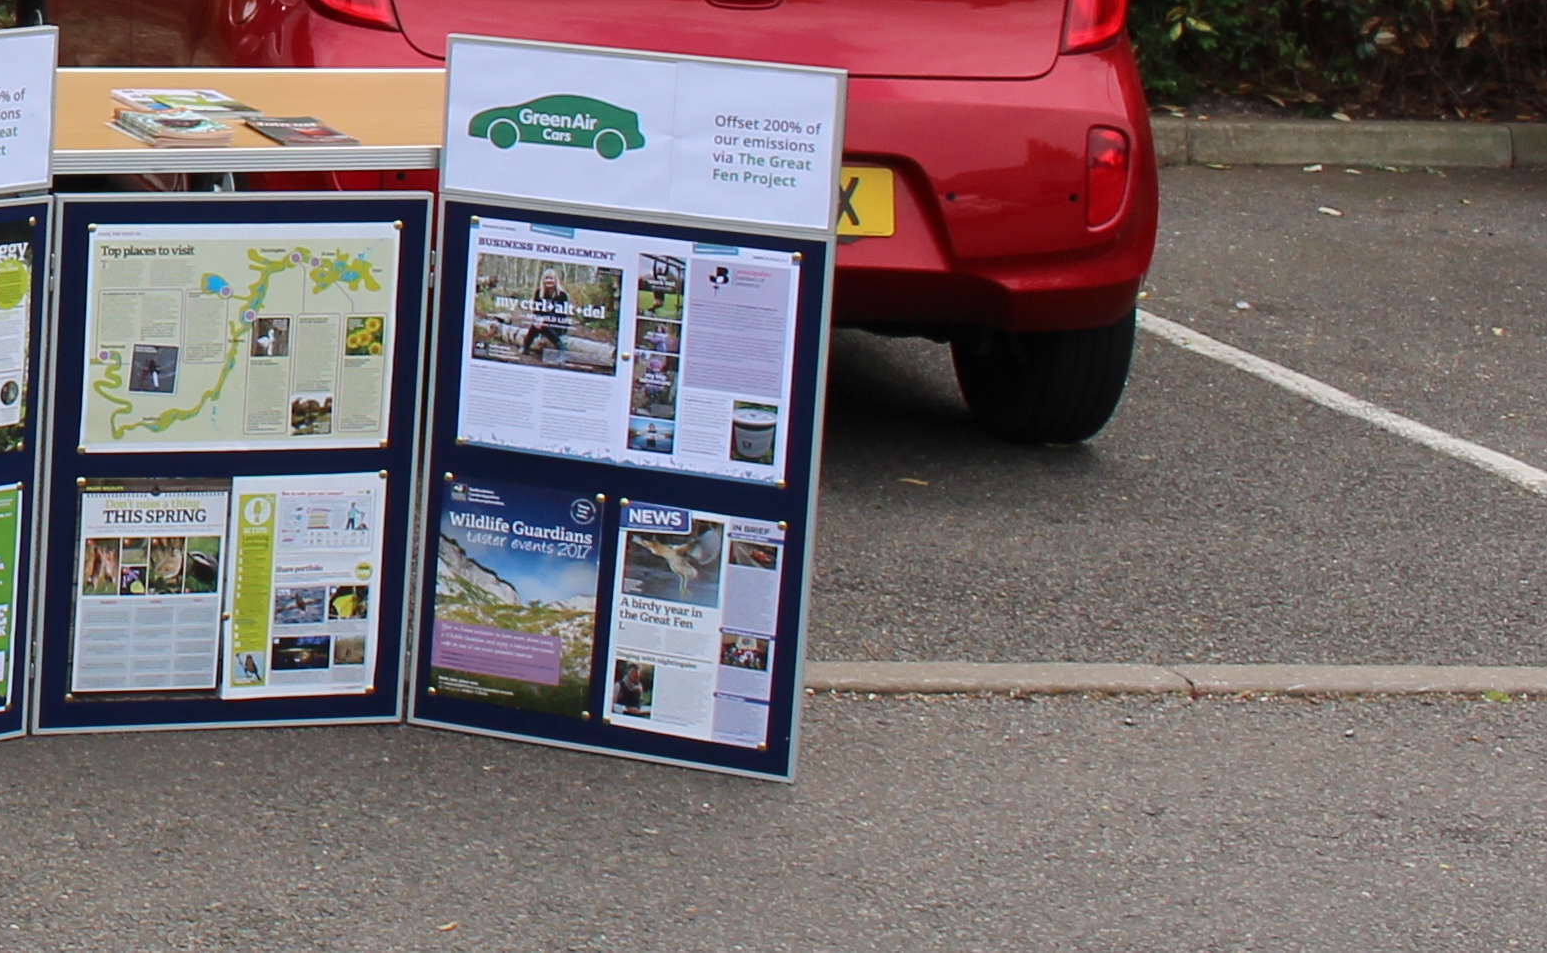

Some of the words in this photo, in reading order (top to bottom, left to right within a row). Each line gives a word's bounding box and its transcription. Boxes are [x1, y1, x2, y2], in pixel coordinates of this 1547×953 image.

[13, 88, 26, 102] of
[542, 128, 572, 143] Cars
[714, 114, 760, 132] Offset
[763, 118, 802, 135] 200%
[805, 120, 822, 136] of
[713, 133, 739, 148] our
[742, 134, 815, 154] emissions
[712, 150, 734, 165] via
[738, 152, 765, 167] The
[768, 154, 811, 171] Great
[712, 168, 739, 183] Fen
[742, 170, 797, 189] Project
[100, 245, 122, 259] Top
[123, 245, 157, 258] places
[158, 246, 171, 256] to
[172, 244, 196, 256] visit
[478, 237, 533, 251] BUSINESS
[536, 244, 616, 261] ENGAGEMENT
[495, 296, 518, 311] my
[520, 297, 606, 319] ctrl+alt+del
[105, 499, 133, 509] Don't
[136, 500, 161, 508] miss
[170, 499, 201, 510] thing
[103, 509, 143, 523] THIS
[145, 509, 207, 523] SPRING
[629, 508, 682, 527] NEWS
[449, 510, 510, 534] Wildlife
[512, 520, 593, 545] Guardians
[744, 525, 770, 535] BRIEF
[466, 530, 508, 547] taster
[511, 538, 555, 555] events
[557, 542, 592, 560] 2017
[620, 597, 629, 606] A
[631, 598, 662, 614] birdy
[664, 603, 689, 618] year
[691, 607, 703, 618] in
[619, 608, 638, 621] the
[640, 612, 670, 626] Great
[673, 618, 694, 629] Fen
